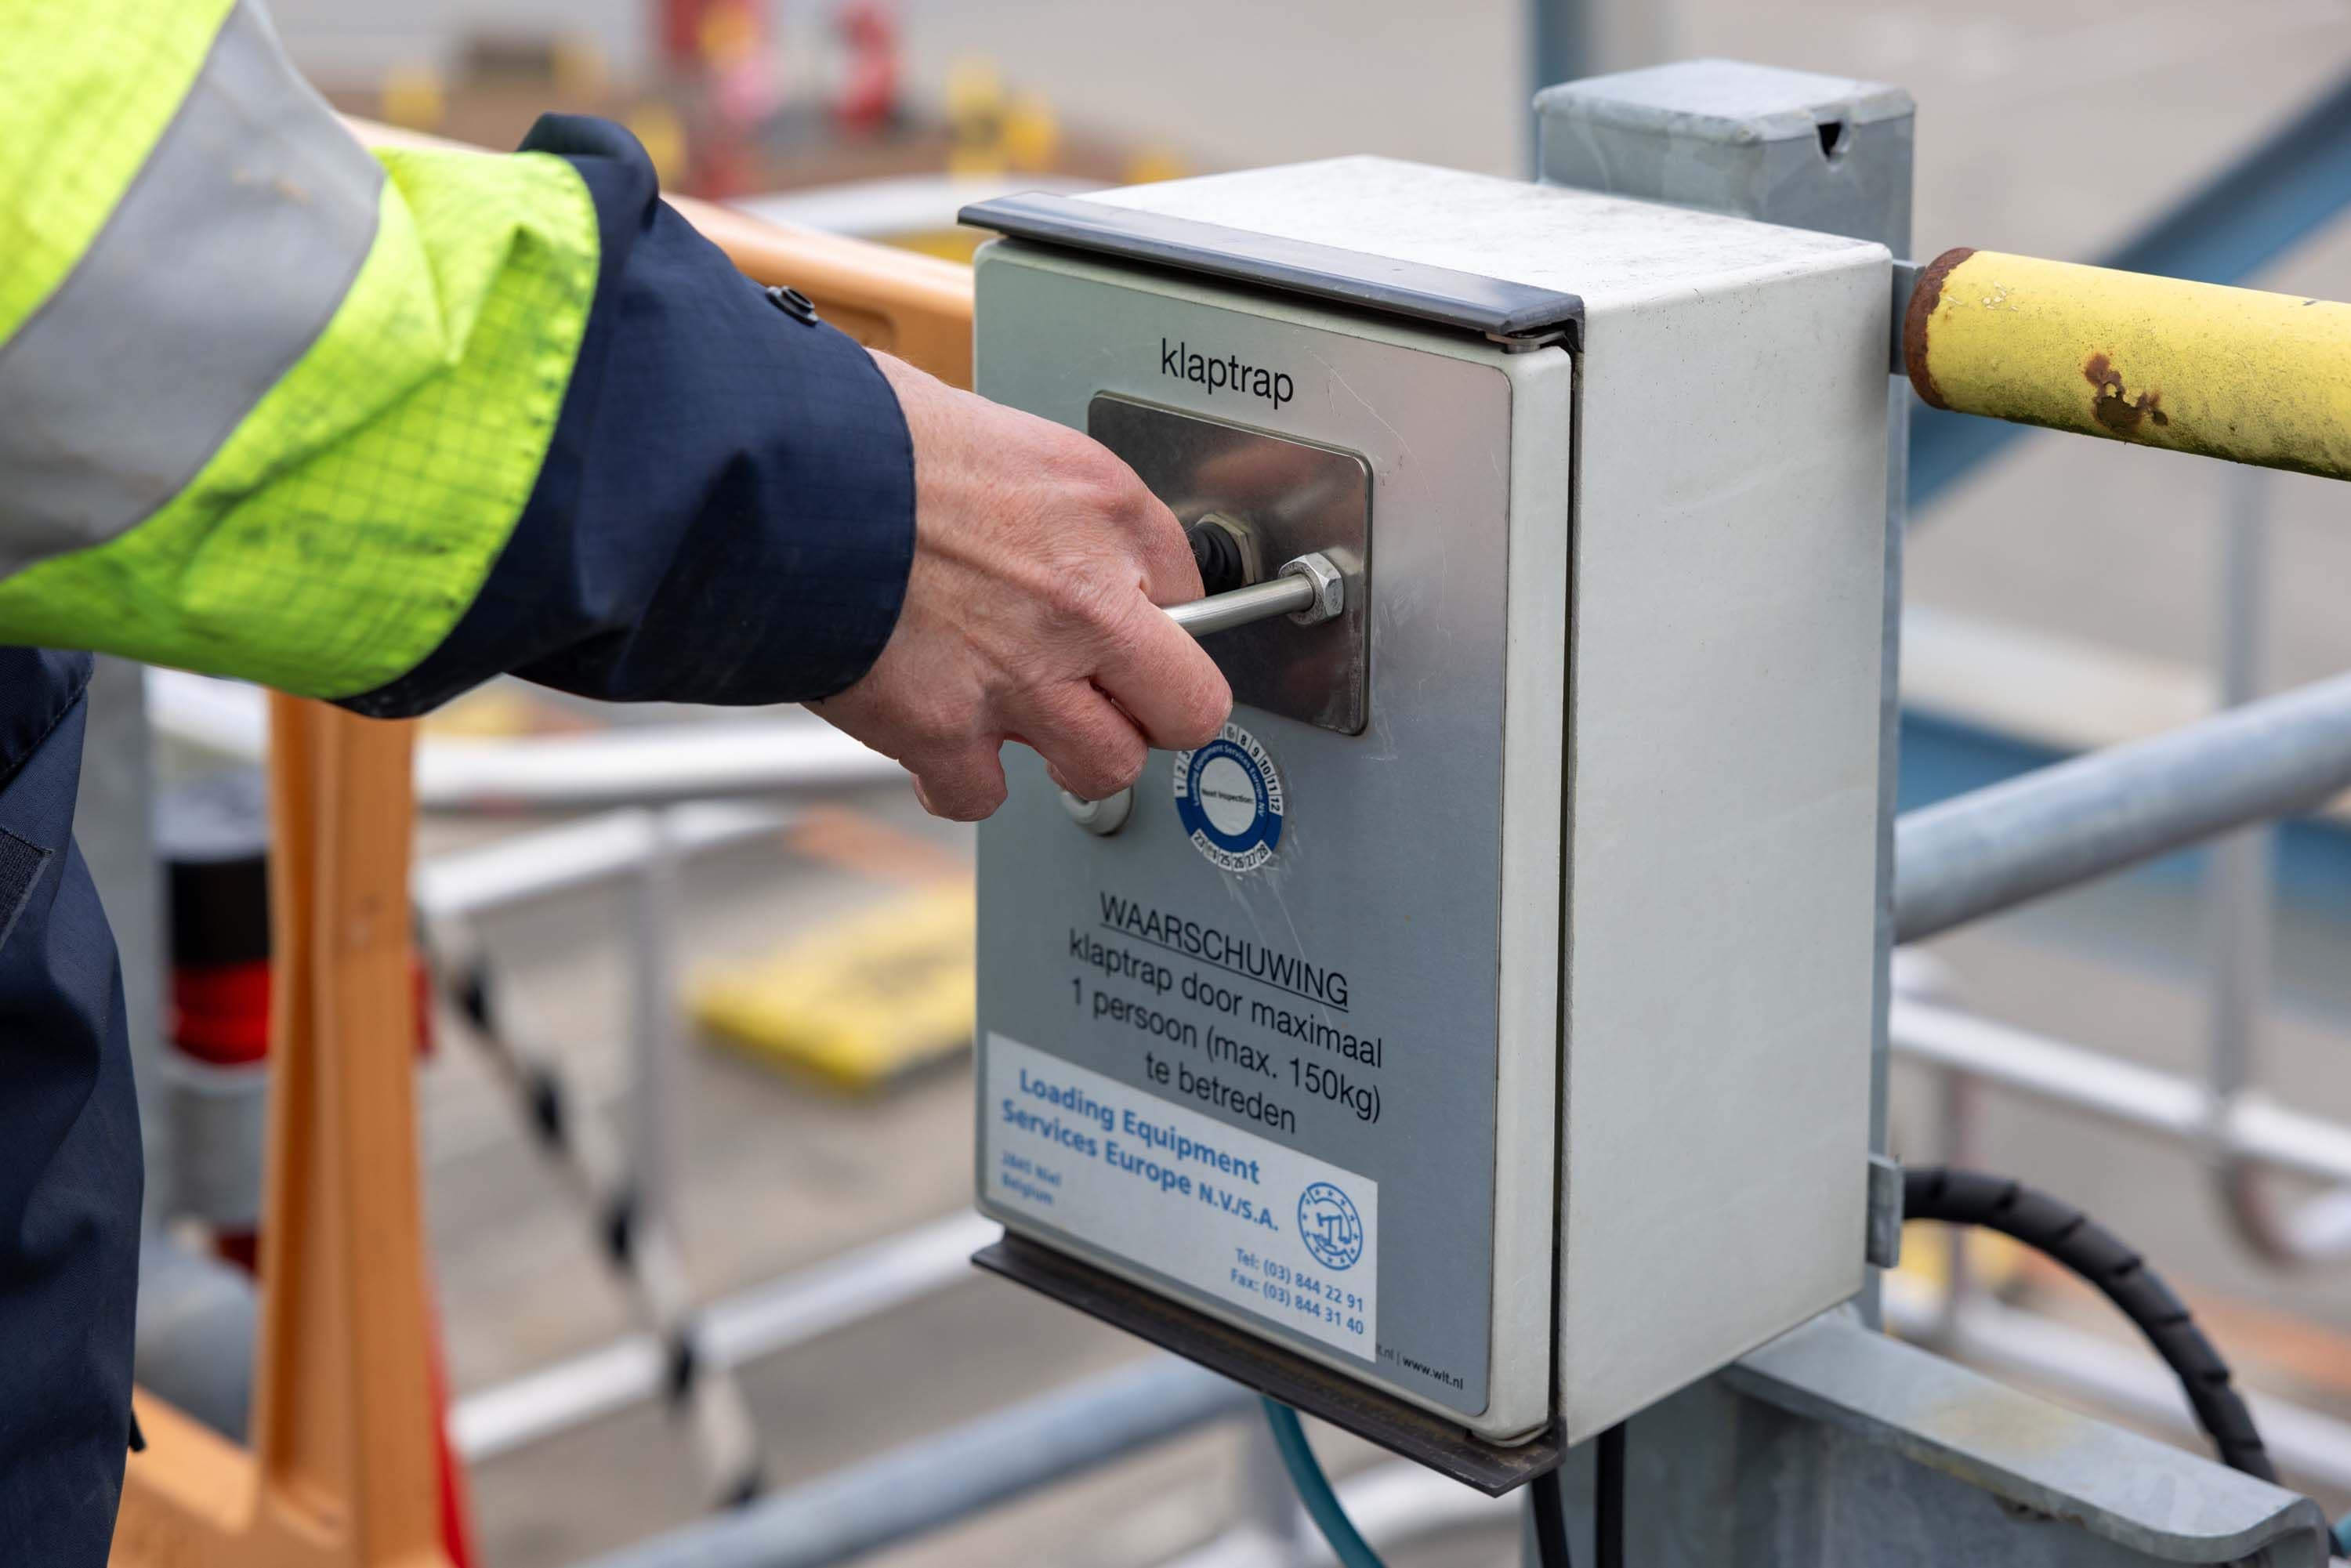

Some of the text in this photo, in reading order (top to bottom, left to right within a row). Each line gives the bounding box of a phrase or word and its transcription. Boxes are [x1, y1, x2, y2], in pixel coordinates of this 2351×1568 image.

[1161, 337, 1294, 410] klaptrap
[1241, 735, 1247, 746] 8
[1252, 746, 1260, 758] 9
[1259, 760, 1271, 775] 10
[1266, 777, 1277, 791] 11
[1270, 797, 1281, 812] 12
[1100, 890, 1349, 1013] WAARSCHUWING
[1069, 929, 1382, 1069] klaptrap door maximaal
[1071, 977, 1382, 1124] 1 persoon (max. 150kg)
[1020, 1067, 1261, 1185] Loading Equipment
[1145, 1051, 1296, 1135] te betreden
[1002, 1099, 1098, 1157] Services
[1105, 1140, 1192, 1195] Europe
[1230, 1268, 1364, 1334] Fax: (03) 844 31 40
[1237, 1248, 1364, 1313] Tel: (03) 844 22 91
[1403, 1356, 1464, 1390] www.wlt.nl
